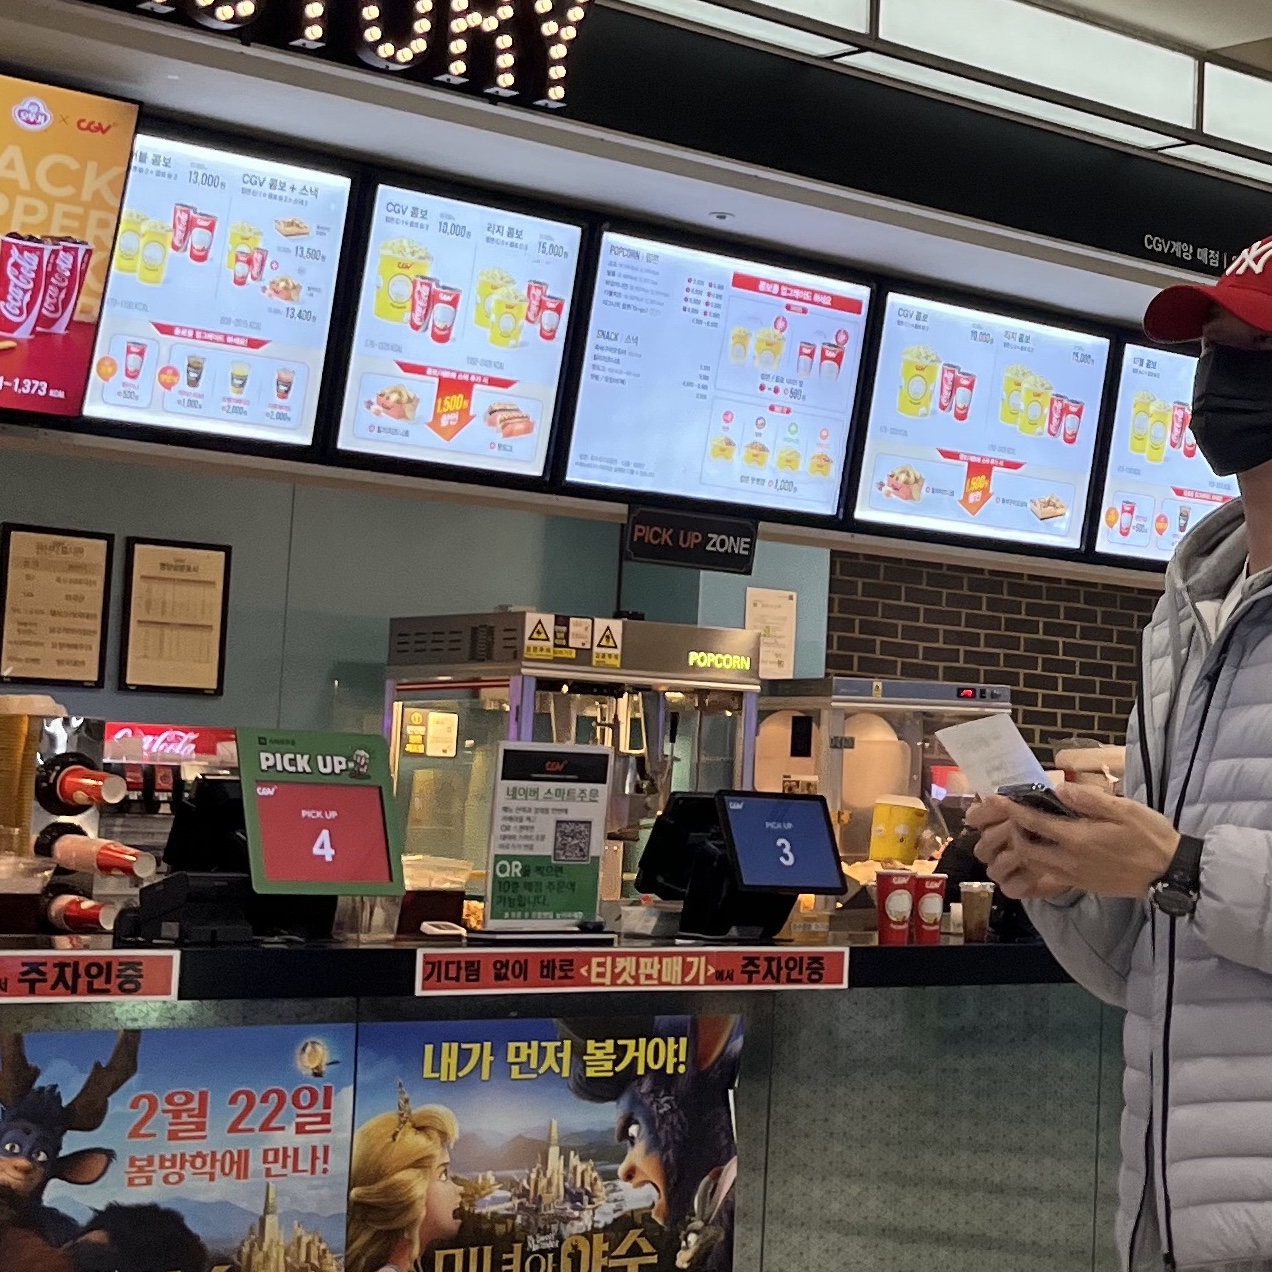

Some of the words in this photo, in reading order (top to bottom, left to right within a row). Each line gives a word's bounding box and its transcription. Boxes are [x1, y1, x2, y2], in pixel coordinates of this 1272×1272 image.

[76, 118, 112, 136] CGV
[242, 173, 266, 187] CGV
[386, 201, 409, 216] CGV
[1144, 233, 1194, 262] CGV계양
[1197, 246, 1221, 269] 매점
[633, 524, 674, 547] PICK
[678, 530, 703, 549] UP
[705, 533, 751, 556] ZONE
[688, 651, 751, 671] POPCORN
[260, 751, 312, 774] PICK
[316, 755, 347, 774] UP
[506, 786, 540, 801] 네이버
[543, 787, 600, 803] 스마트주문
[301, 809, 323, 820] PICK
[324, 810, 338, 820] UP
[312, 829, 336, 863] 4
[776, 838, 795, 866] 3
[423, 960, 481, 983] 기다림
[493, 958, 529, 982] 없이
[539, 958, 575, 981] 바로
[421, 1041, 495, 1082] 내가
[506, 1039, 573, 1080] 먼저
[583, 1036, 689, 1078] 볼거야!
[126, 1088, 210, 1142] 2월
[226, 1085, 334, 1137] 22일
[124, 1148, 250, 1188] 봄방학에
[261, 1144, 331, 1179] 만나!
